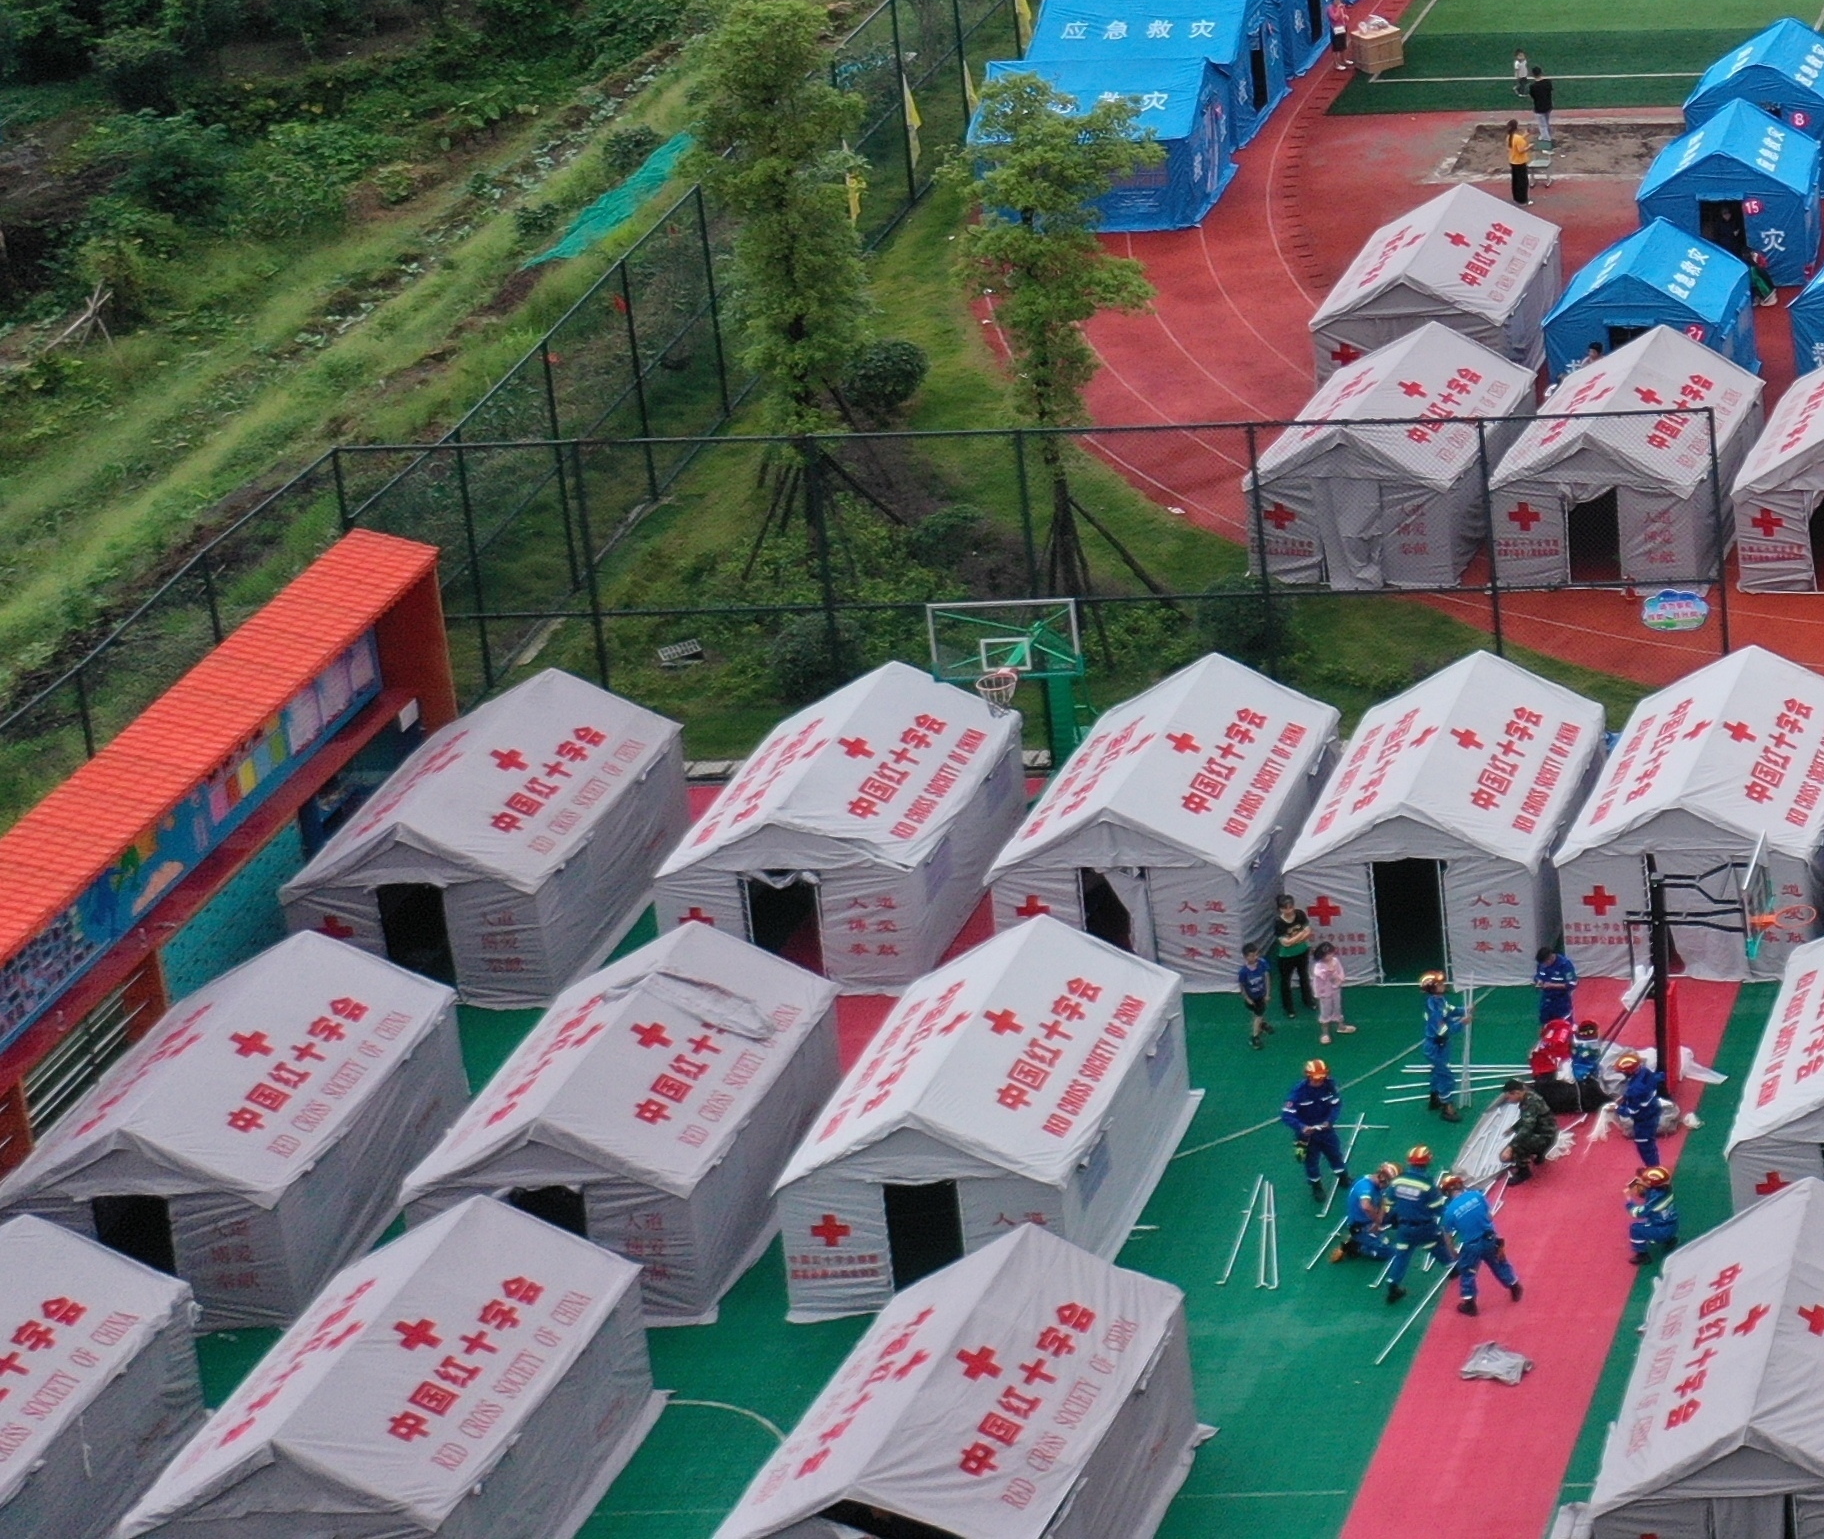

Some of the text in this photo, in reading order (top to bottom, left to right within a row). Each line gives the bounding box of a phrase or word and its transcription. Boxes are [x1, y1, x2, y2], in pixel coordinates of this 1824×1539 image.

[1060, 19, 1216, 40] 应急救灾
[1794, 114, 1805, 125] 8
[1459, 221, 1516, 288] 中国红十字会
[1745, 202, 1760, 214] 15
[491, 725, 607, 832] 中国红十字会
[847, 713, 947, 819] 中国红十字会
[1181, 707, 1268, 814] 中国红十字会
[1470, 705, 1544, 810] 中国红十字会
[1744, 697, 1814, 803] 中国红十字会
[228, 996, 369, 1132] 中国红十字会
[634, 1022, 723, 1124] 中国红十
[997, 977, 1102, 1110] 中国红十字会
[1079, 1038, 1114, 1082] SOCIETY
[1104, 1021, 1128, 1040] OF
[264, 1011, 412, 1159] RED CROSS SOCIETY OF CHINA
[1041, 1112, 1074, 1138] RED
[1056, 1078, 1095, 1116] CROSS
[389, 1276, 543, 1440] 中国红十字会
[427, 1290, 592, 1471] RED CROSS SOCIETY OF CHINA
[959, 1302, 1096, 1476] 中国红十字会
[1664, 1264, 1742, 1429] 中国红十字会
